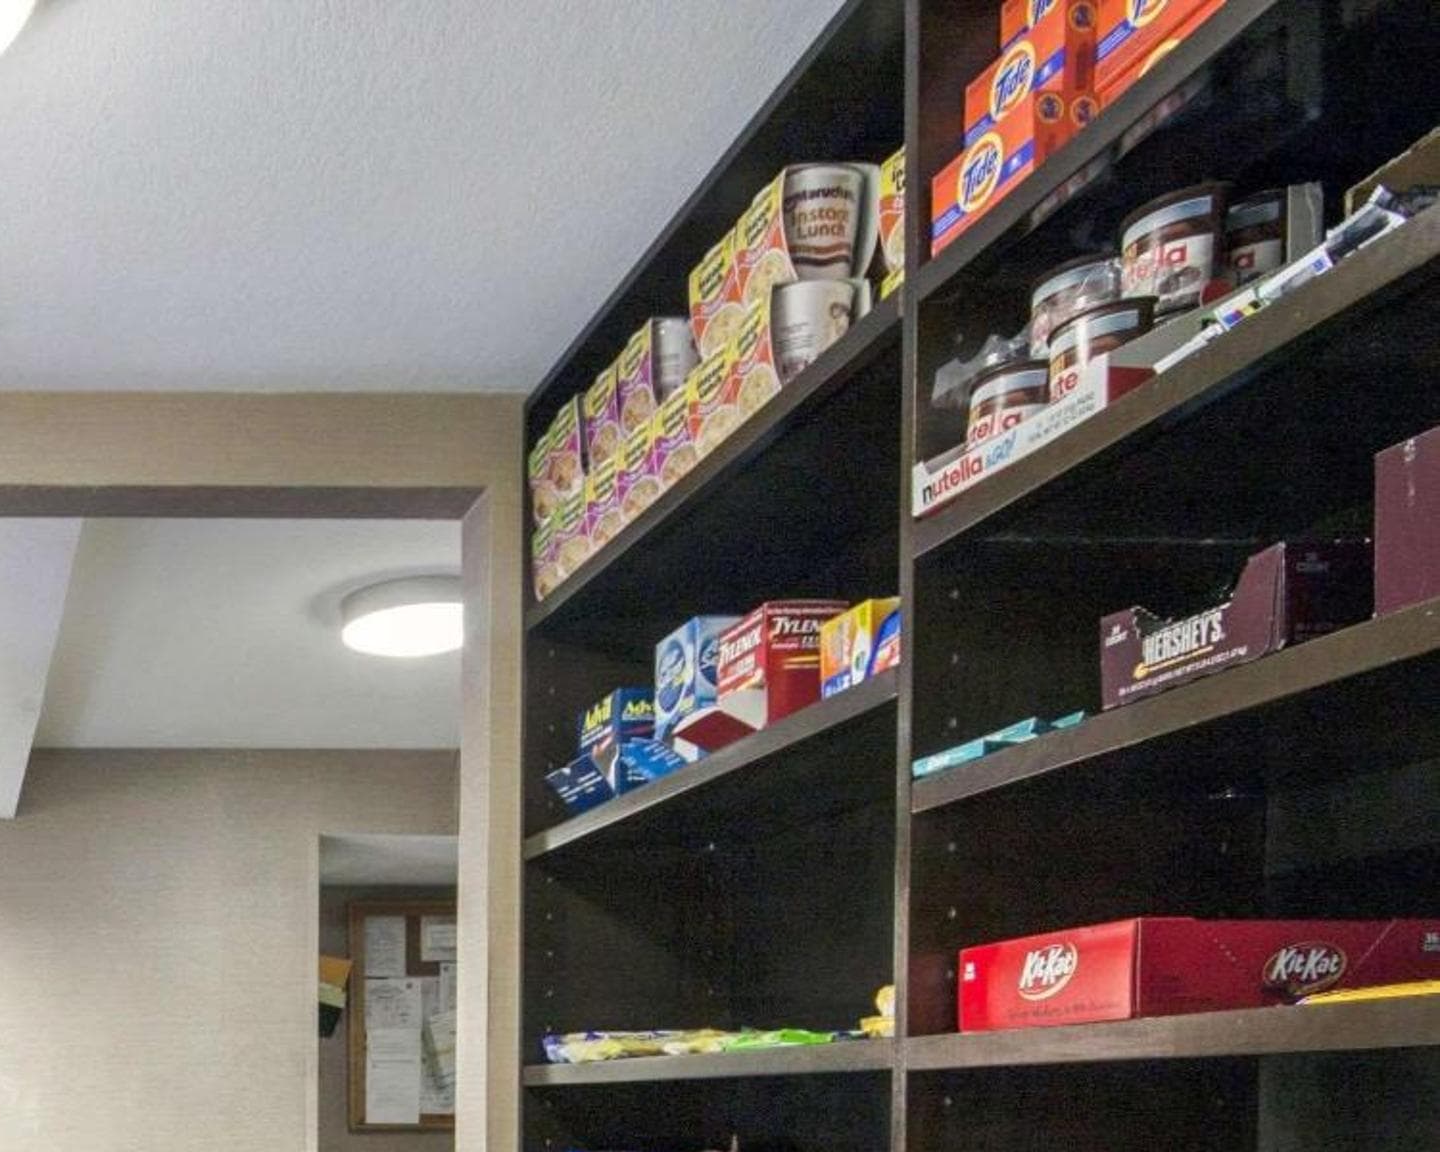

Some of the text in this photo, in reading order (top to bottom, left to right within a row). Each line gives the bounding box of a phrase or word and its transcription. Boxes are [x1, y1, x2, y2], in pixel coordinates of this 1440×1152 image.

[961, 148, 1000, 208] Tide
[922, 455, 984, 503] nutella
[771, 615, 821, 634] TYLEN
